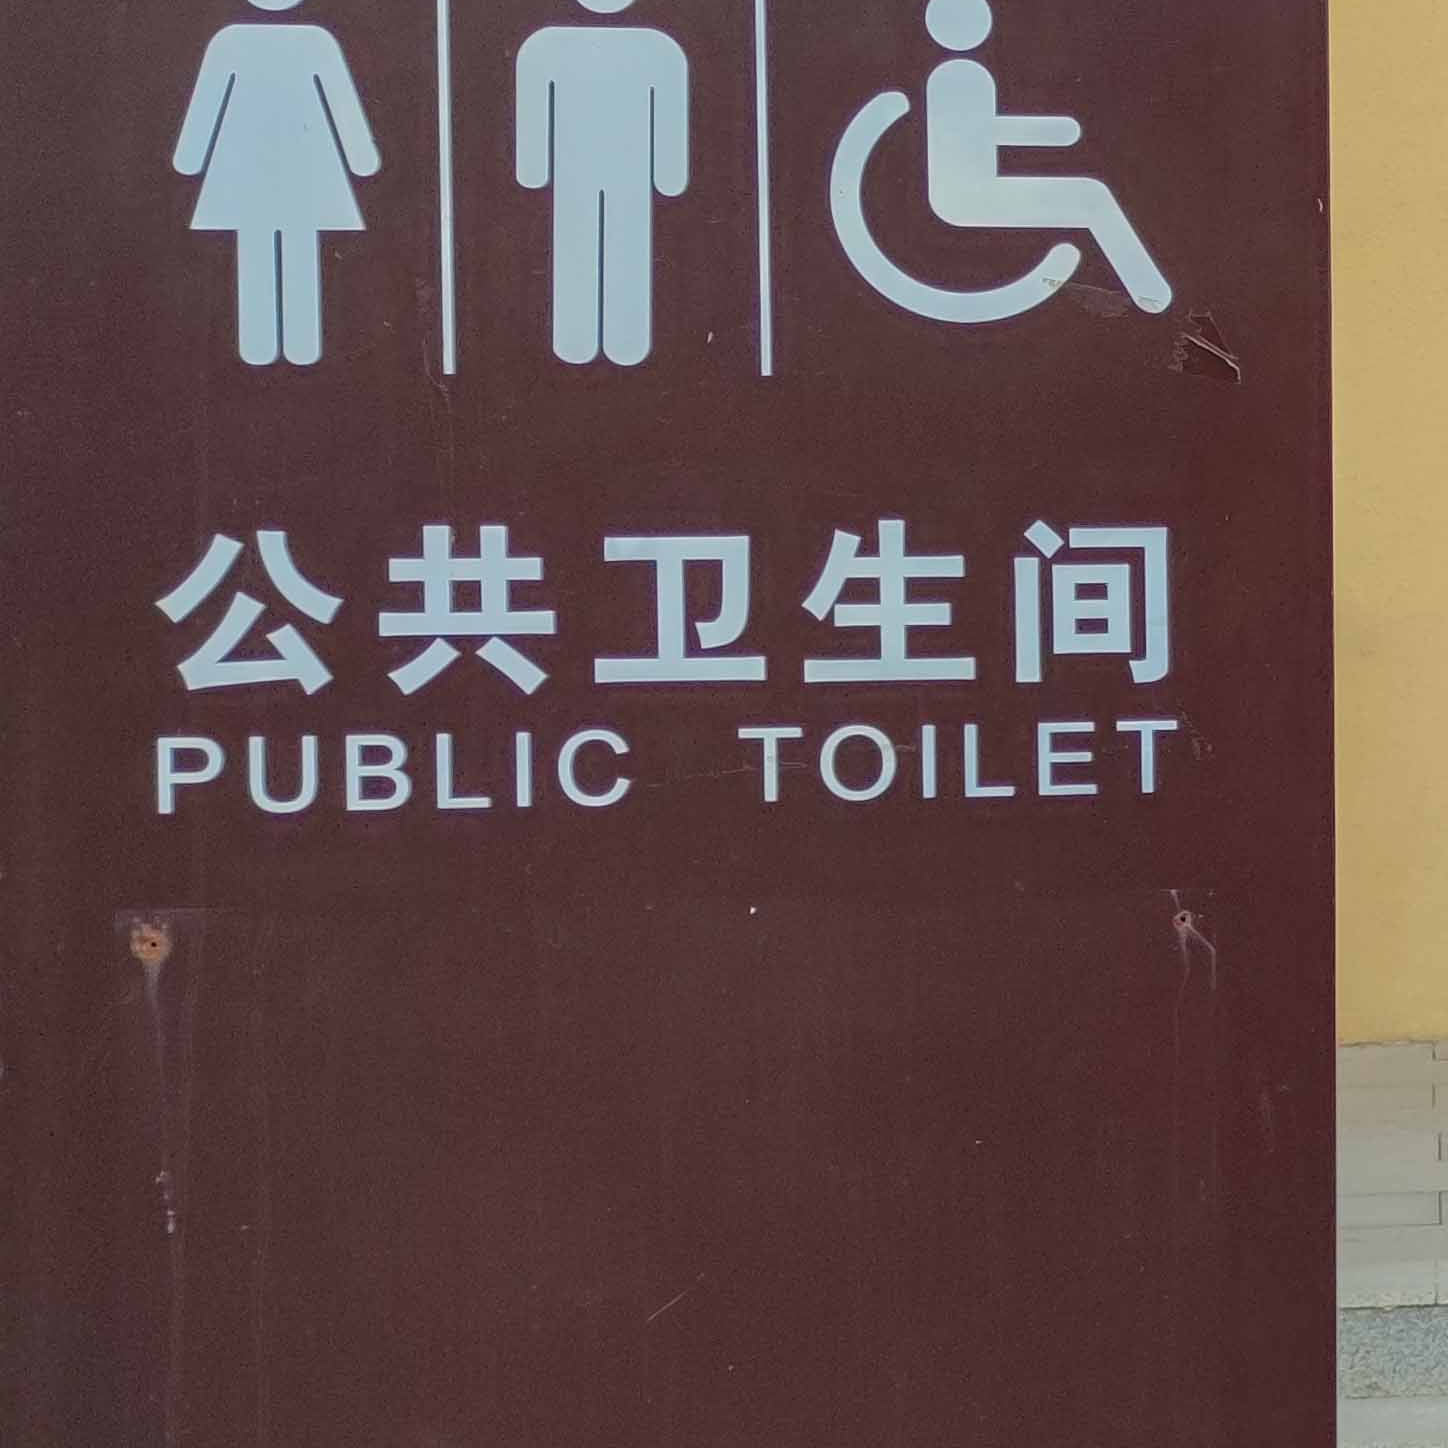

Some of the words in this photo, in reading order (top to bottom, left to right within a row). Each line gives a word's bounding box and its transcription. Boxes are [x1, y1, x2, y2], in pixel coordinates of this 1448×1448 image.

[154, 518, 1170, 696] 公共卫生间
[156, 729, 632, 815] PUBLIC
[737, 719, 1179, 802] TOILET
